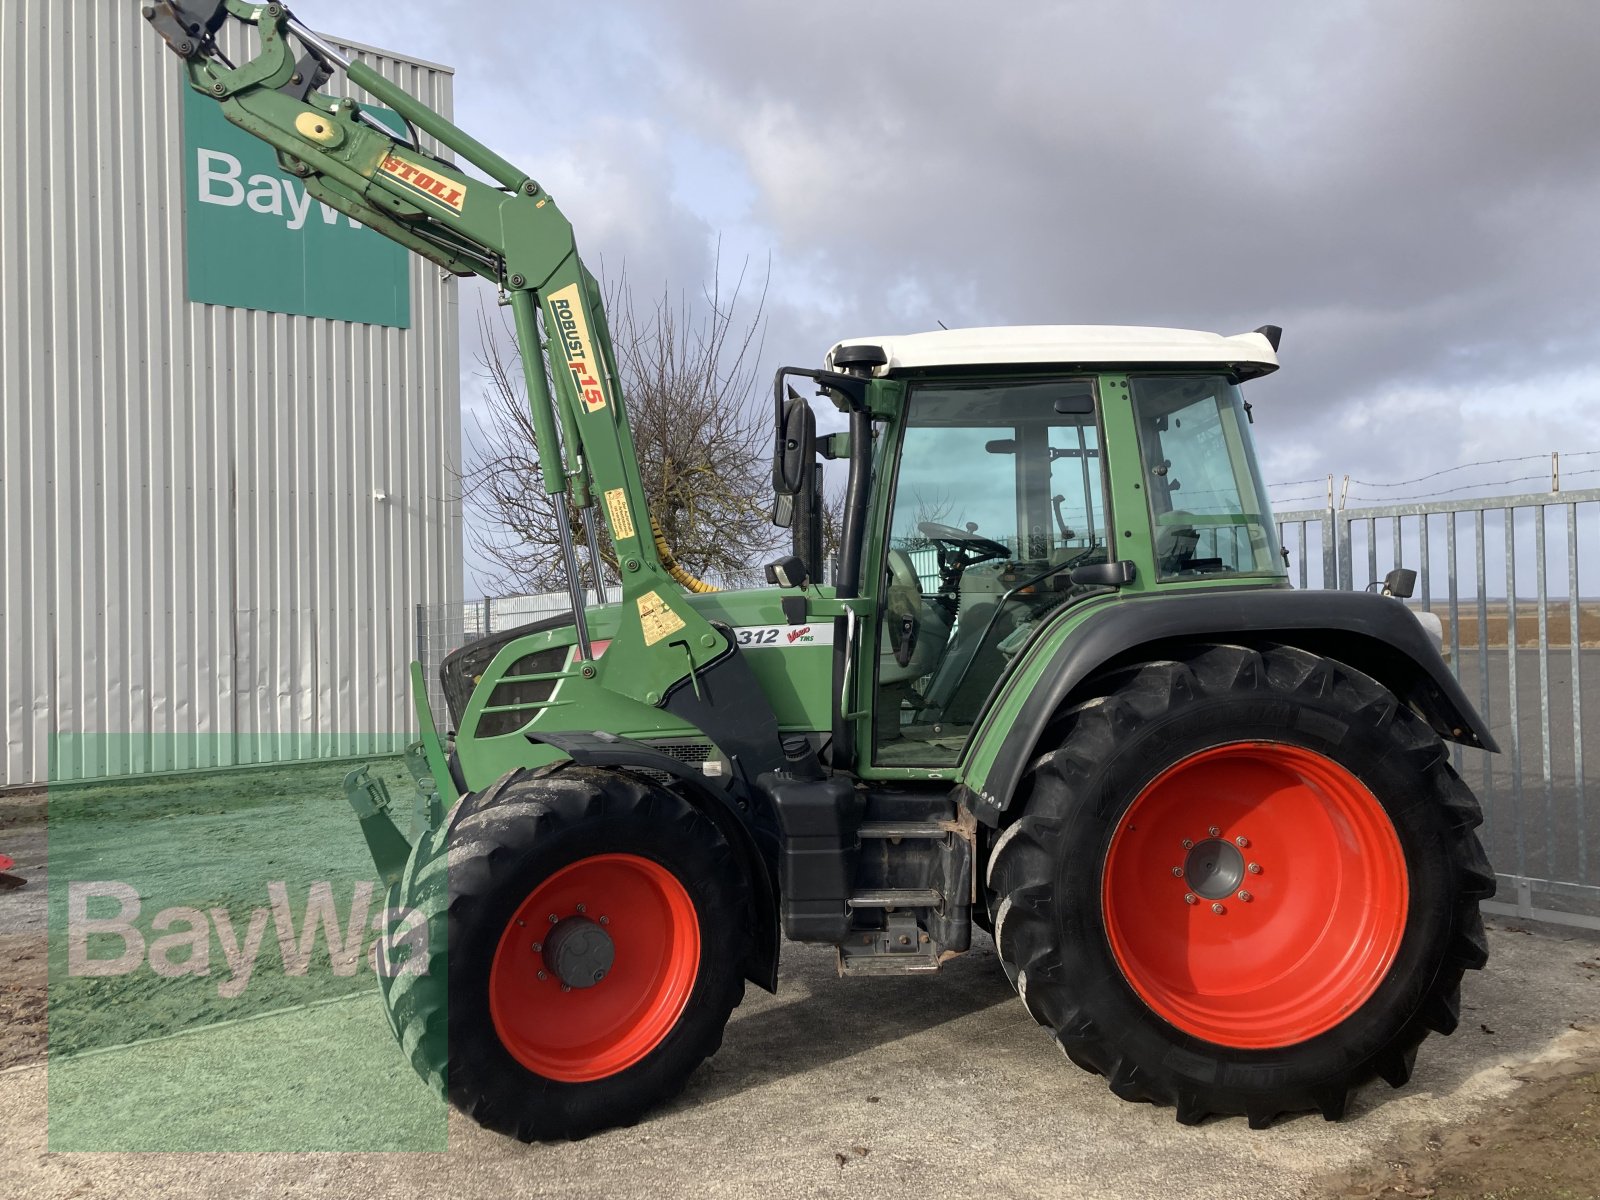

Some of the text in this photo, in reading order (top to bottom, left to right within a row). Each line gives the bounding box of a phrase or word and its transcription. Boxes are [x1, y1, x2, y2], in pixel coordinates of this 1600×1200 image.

[383, 155, 462, 207] STOLL
[555, 299, 585, 359] ROBUST
[737, 628, 780, 645] 312
